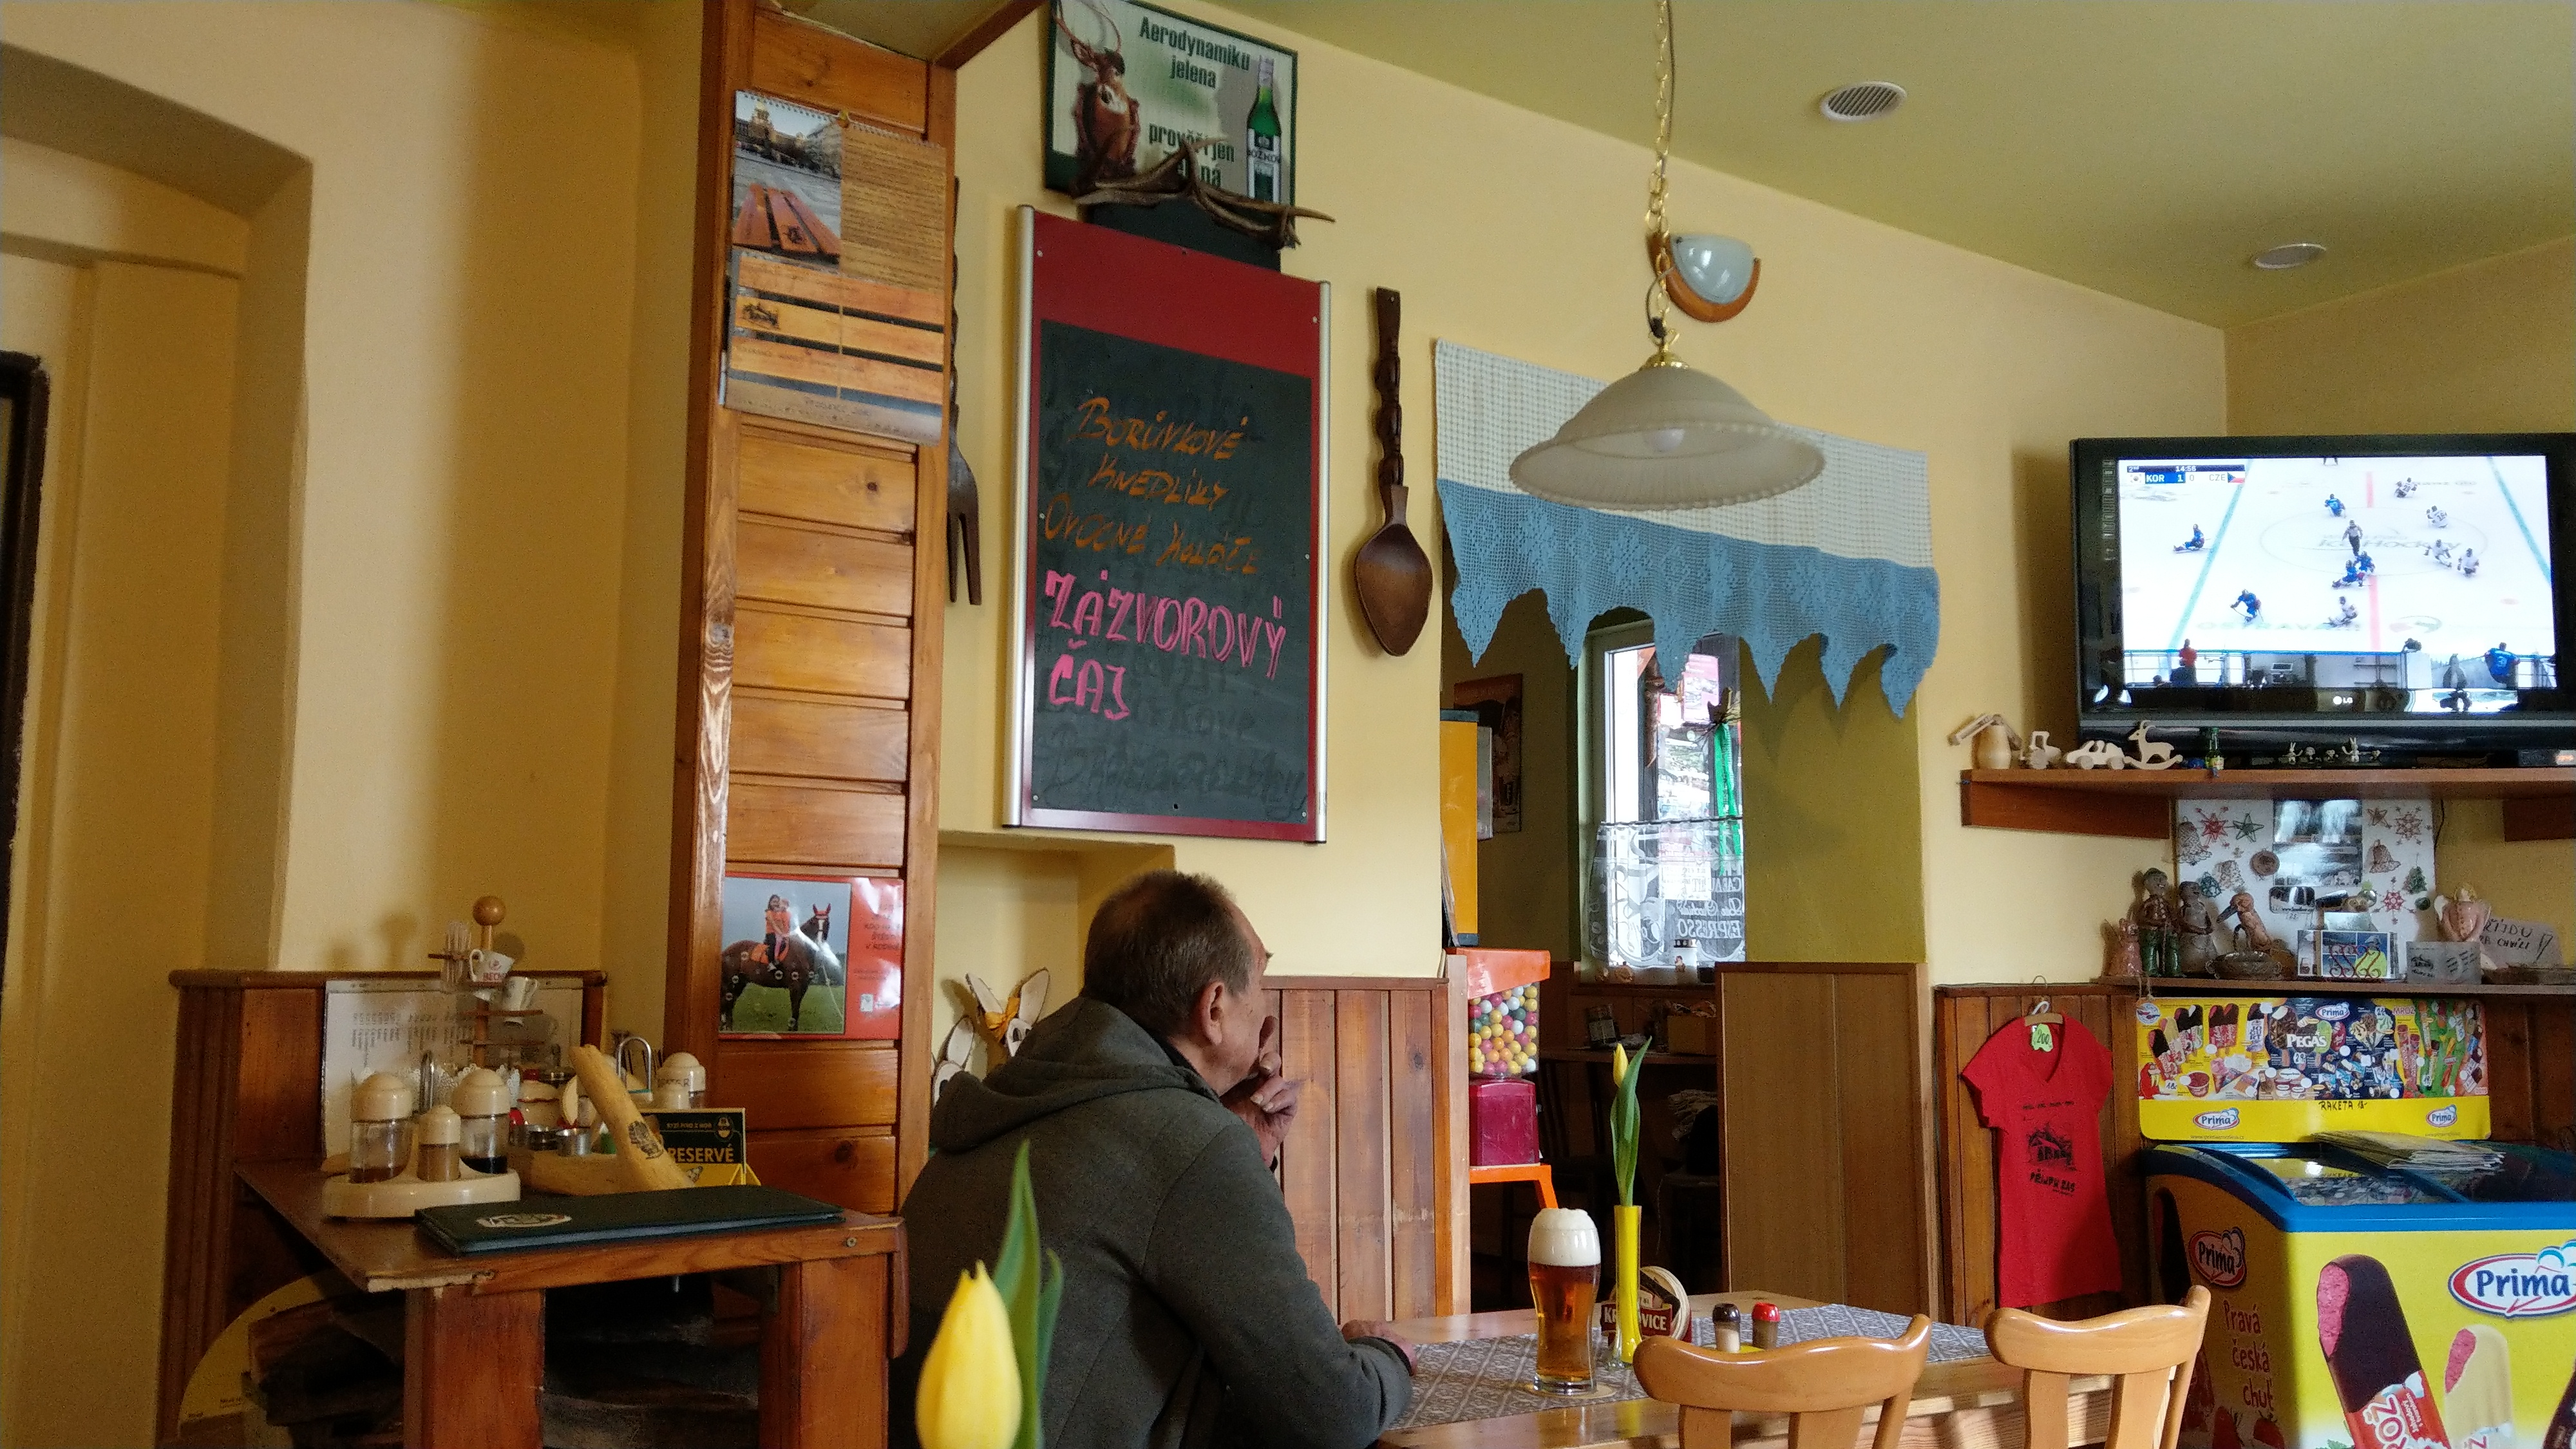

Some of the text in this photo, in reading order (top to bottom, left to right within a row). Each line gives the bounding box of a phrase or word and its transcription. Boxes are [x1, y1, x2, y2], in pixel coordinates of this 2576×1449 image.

[1139, 16, 1250, 71] Aerodynamiku
[1170, 54, 1217, 89] jelena
[1211, 142, 1235, 162] jen
[1200, 166, 1222, 189] na
[1045, 569, 1286, 679] ZÁZVOROVÝ
[1048, 638, 1130, 720] ČAJ
[2322, 1009, 2344, 1017] Prima
[2201, 1115, 2231, 1124] Prima
[2318, 1101, 2353, 1111] RAKETA
[2432, 1114, 2452, 1122] Prima
[667, 1143, 734, 1162] RESERVÉ
[2198, 1241, 2235, 1275] Prima
[2476, 1267, 2571, 1297] Prima
[1604, 1306, 1667, 1331] KRVICE
[2224, 1300, 2260, 1334] Pravá
[2232, 1338, 2269, 1373] česká
[2243, 1378, 2273, 1411] chuť
